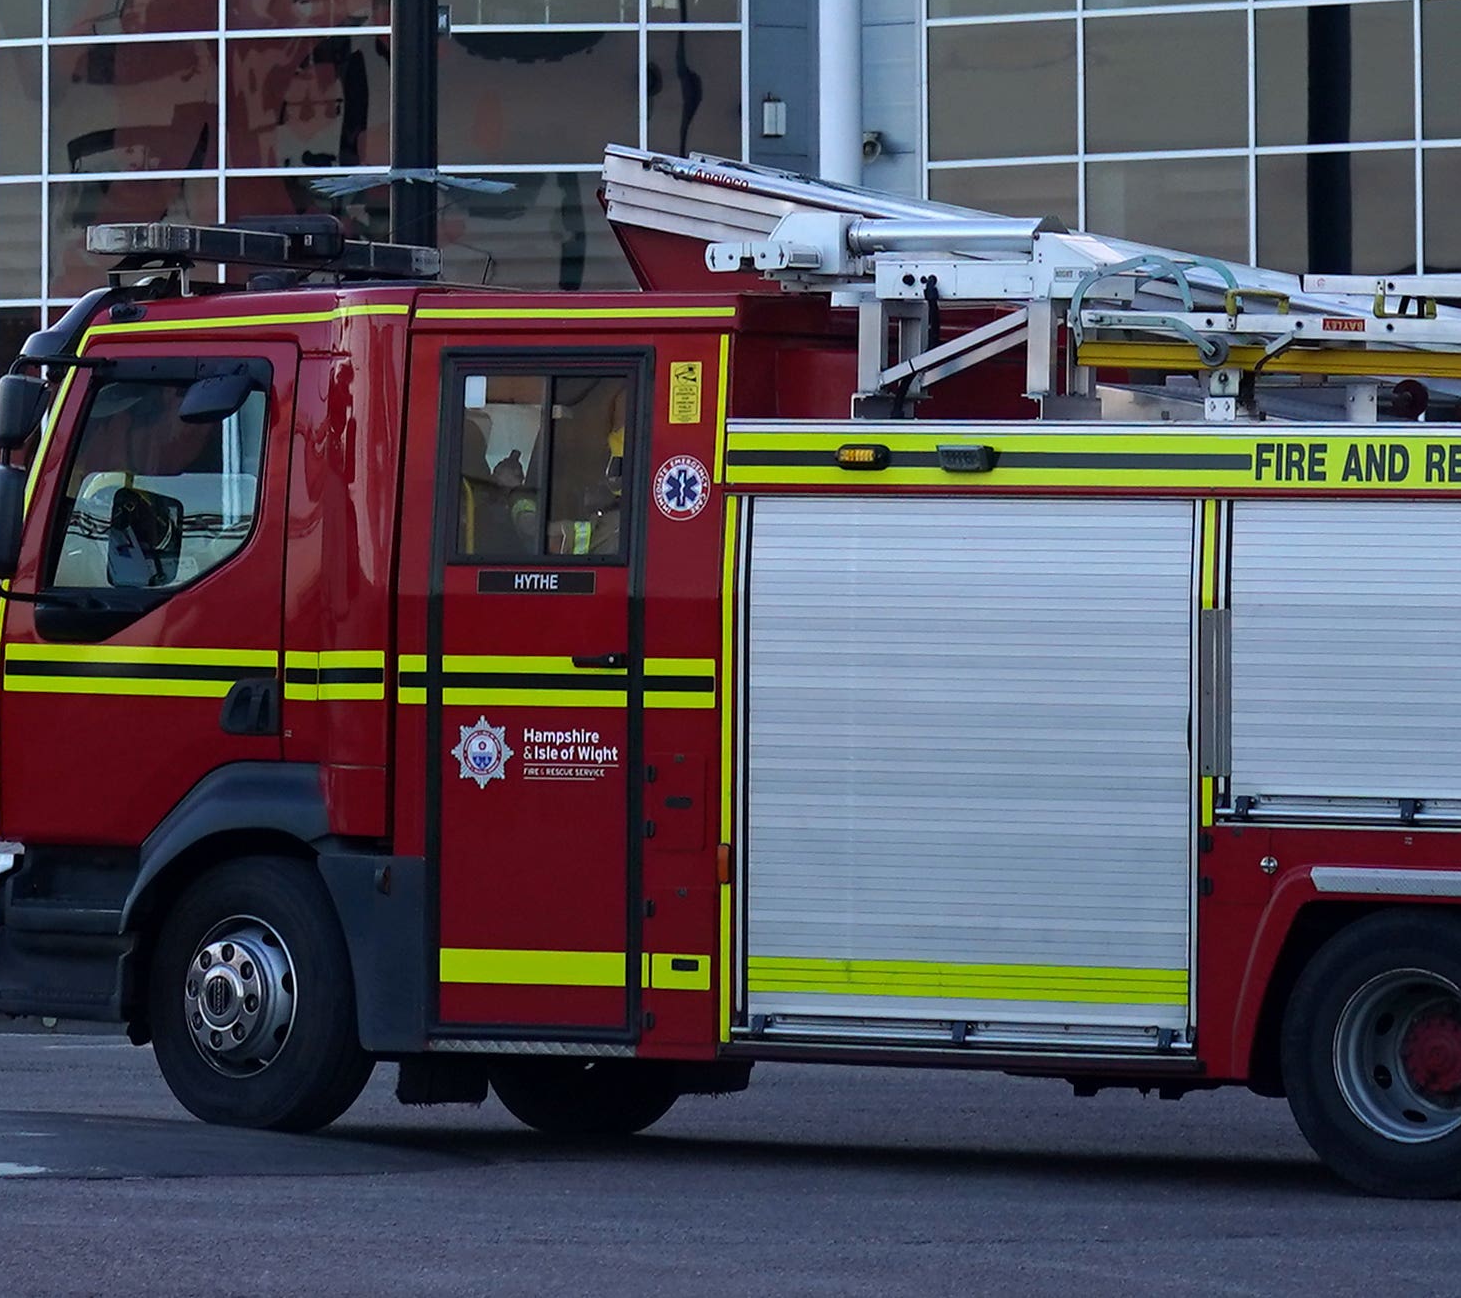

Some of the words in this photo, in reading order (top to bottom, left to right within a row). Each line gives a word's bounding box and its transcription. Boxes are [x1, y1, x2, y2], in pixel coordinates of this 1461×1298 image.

[1255, 442, 1328, 481] FIRE
[1341, 443, 1410, 482] AND
[670, 458, 708, 488] EMERGENCY
[690, 493, 707, 515] CARE
[514, 574, 559, 590] HYTHE
[523, 728, 600, 744] Hampshire
[523, 745, 532, 760] &
[534, 745, 558, 760] Isle
[560, 745, 574, 760] of
[576, 745, 618, 764] Wight
[523, 768, 539, 776] FIRE
[546, 768, 573, 776] RESCUE
[575, 768, 605, 777] SERVICE
